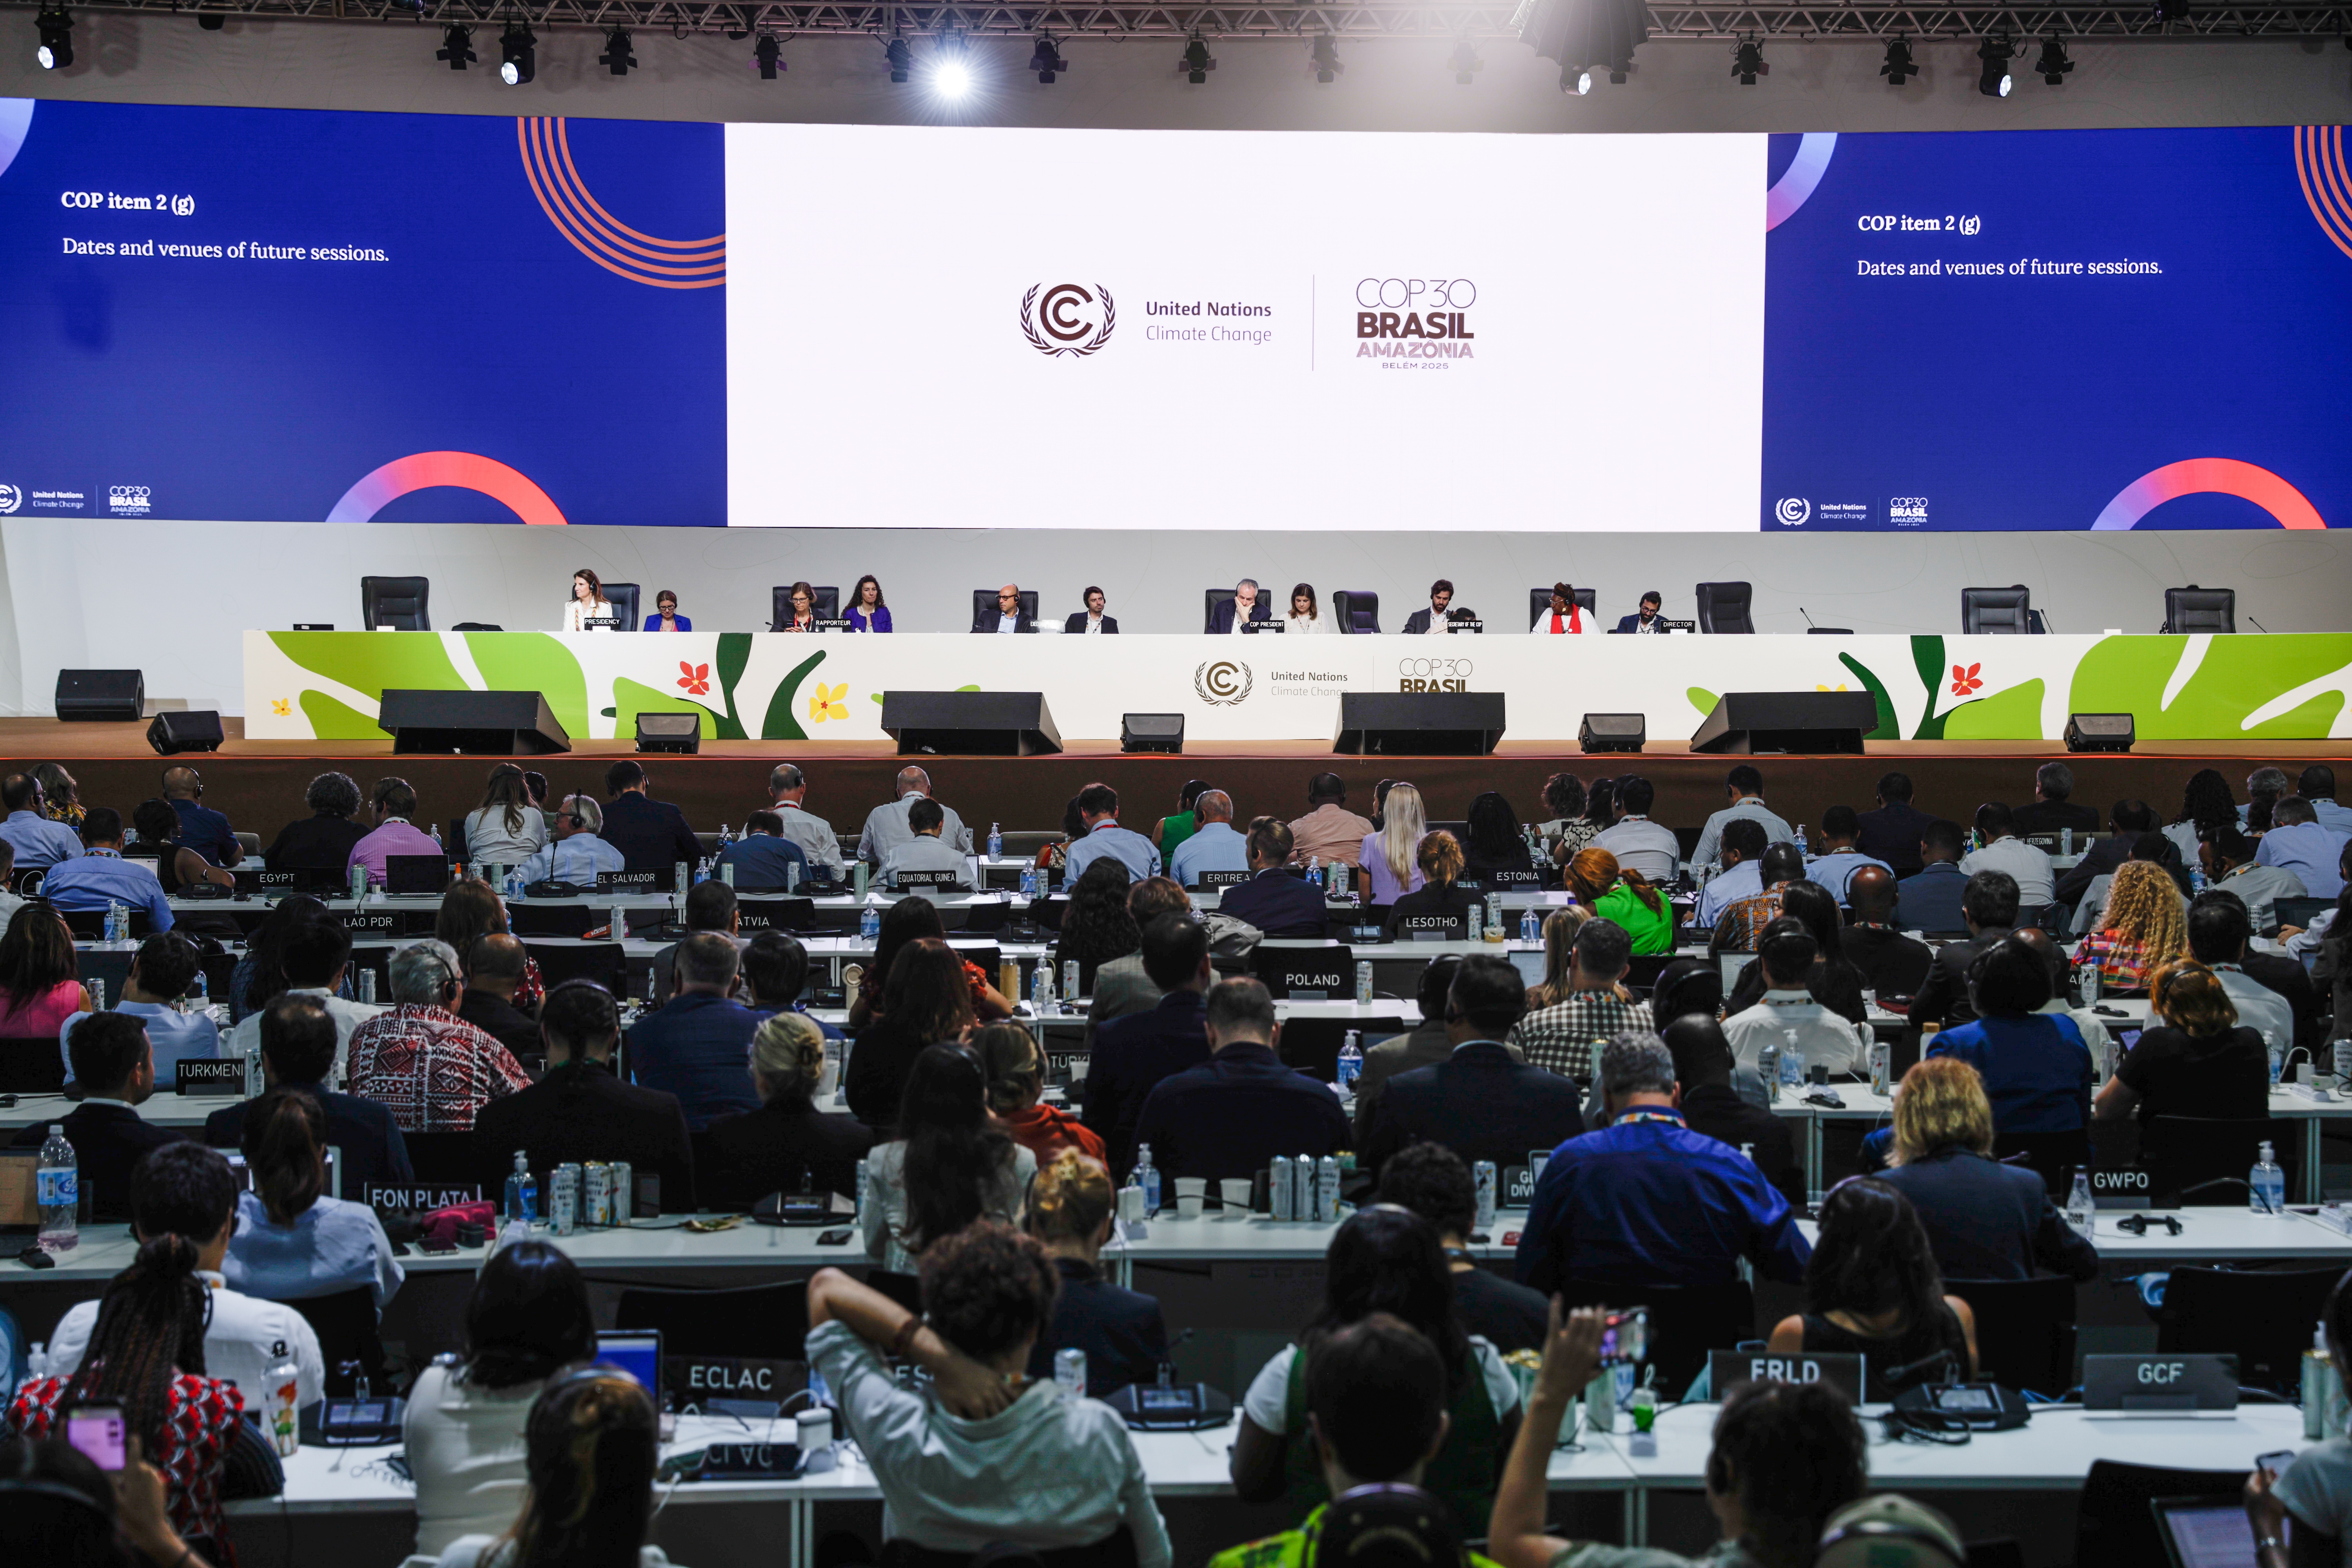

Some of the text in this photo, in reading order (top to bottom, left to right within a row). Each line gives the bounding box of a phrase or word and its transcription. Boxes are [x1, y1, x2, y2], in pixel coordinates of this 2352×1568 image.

[61, 191, 195, 216] COP item 2 (g)
[1858, 214, 1981, 235] COP item 2 (g)
[63, 238, 389, 261] Dates and venues of future sessions.
[1857, 258, 2162, 276] Dates and venues of future sessions.
[1146, 301, 1271, 316] United Nations
[1357, 312, 1474, 339] BRASIL
[1146, 325, 1272, 345] Climate Change
[1356, 340, 1474, 358] AMAZÔNIA
[109, 486, 151, 497] COP30
[59, 501, 84, 509] Change
[109, 496, 151, 506] BRASIL
[1891, 497, 1928, 508] COP30
[1890, 508, 1927, 517] BRASIL
[1271, 671, 1348, 681] United Nations
[1271, 686, 1308, 695] Climate
[1400, 679, 1472, 693] BRASIL
[260, 874, 295, 882] EGYPT
[598, 873, 655, 883] EL SALVADOR
[898, 873, 955, 882] EQUATORIAL GUINEA
[1207, 874, 1250, 882] ERITREA
[1497, 872, 1539, 880] ESTONIA
[344, 917, 392, 927] LAO PDR
[1406, 917, 1457, 927] LESOTHO
[1286, 974, 1340, 986] POLAND
[179, 1063, 243, 1077] TURKMENI
[2094, 1172, 2149, 1189] GWPO
[372, 1189, 470, 1209] FON PLATA
[690, 1365, 772, 1391] ECLAC
[1751, 1358, 1821, 1385] FRLD
[2137, 1363, 2184, 1385] GCF
